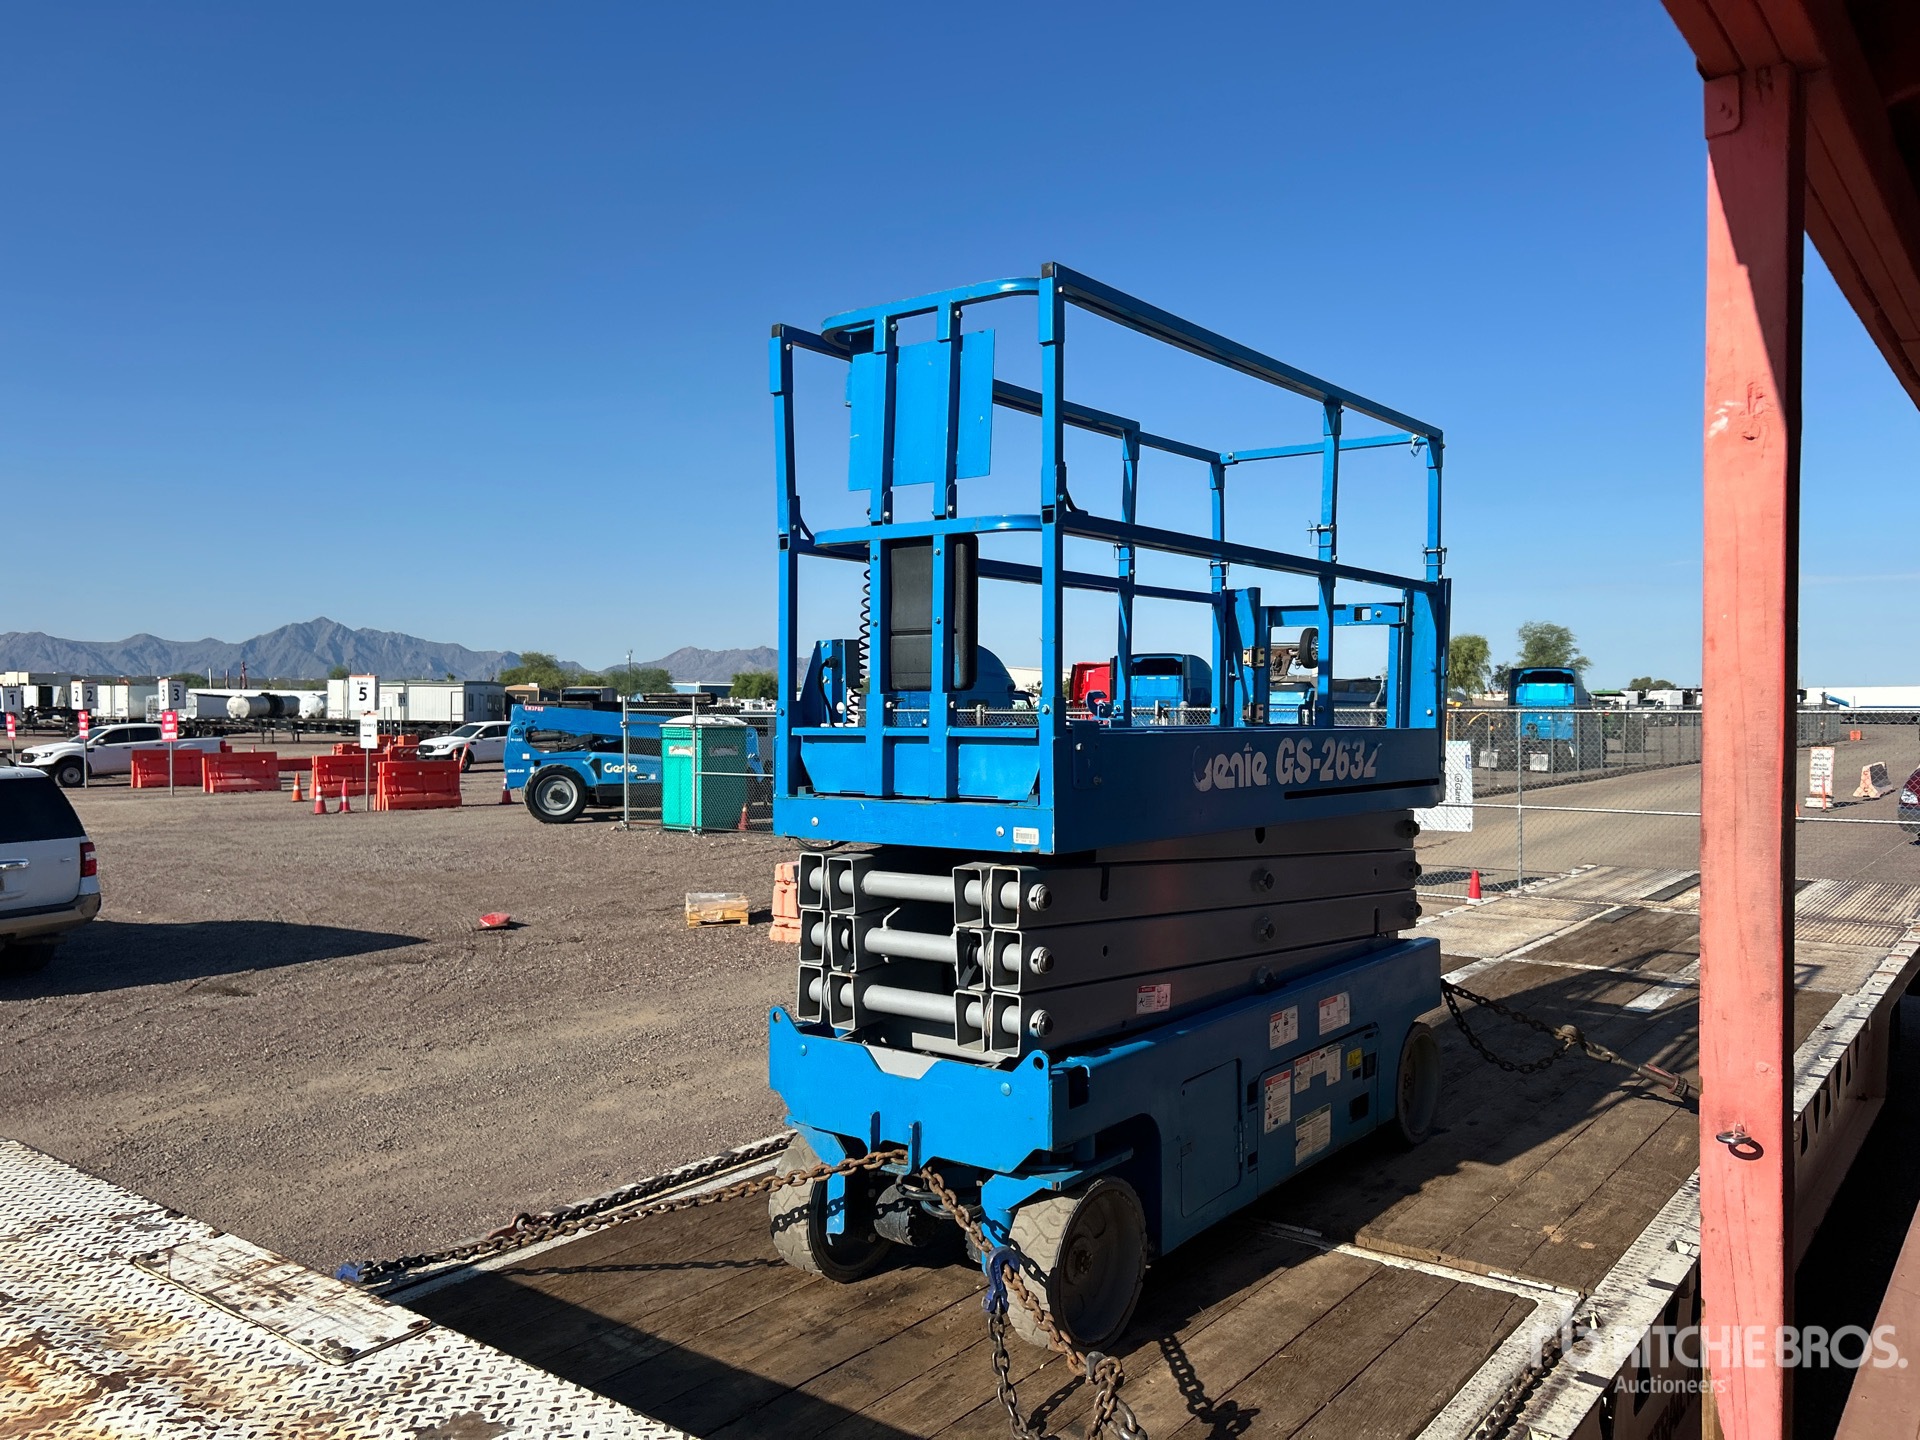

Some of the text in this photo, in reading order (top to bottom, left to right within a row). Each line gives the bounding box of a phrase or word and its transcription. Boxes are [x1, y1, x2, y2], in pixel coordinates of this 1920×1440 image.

[9, 693, 15, 705] 1
[86, 690, 93, 702] 2
[173, 688, 180, 701] 3
[358, 686, 367, 701] 5
[1275, 736, 1382, 785] GS-2632
